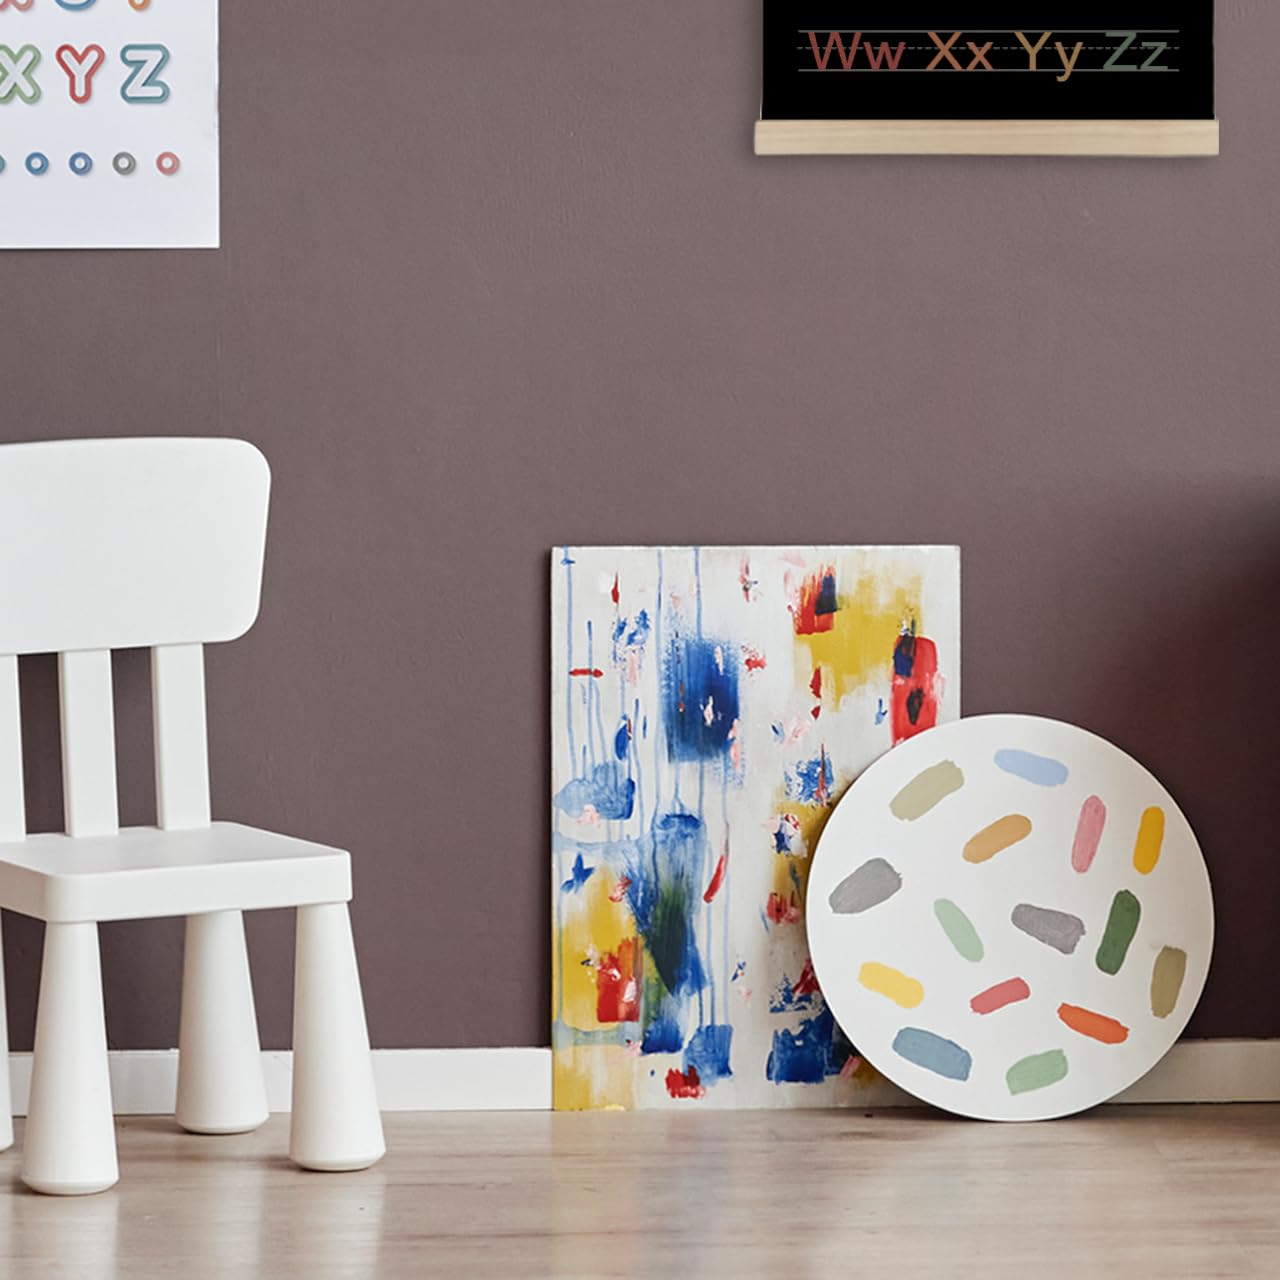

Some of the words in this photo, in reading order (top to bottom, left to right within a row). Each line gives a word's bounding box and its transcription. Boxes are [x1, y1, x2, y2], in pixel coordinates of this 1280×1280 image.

[807, 31, 906, 70] Ww
[924, 31, 994, 70] Xx
[1014, 31, 1083, 81] Yy
[1102, 31, 1169, 70] Zz
